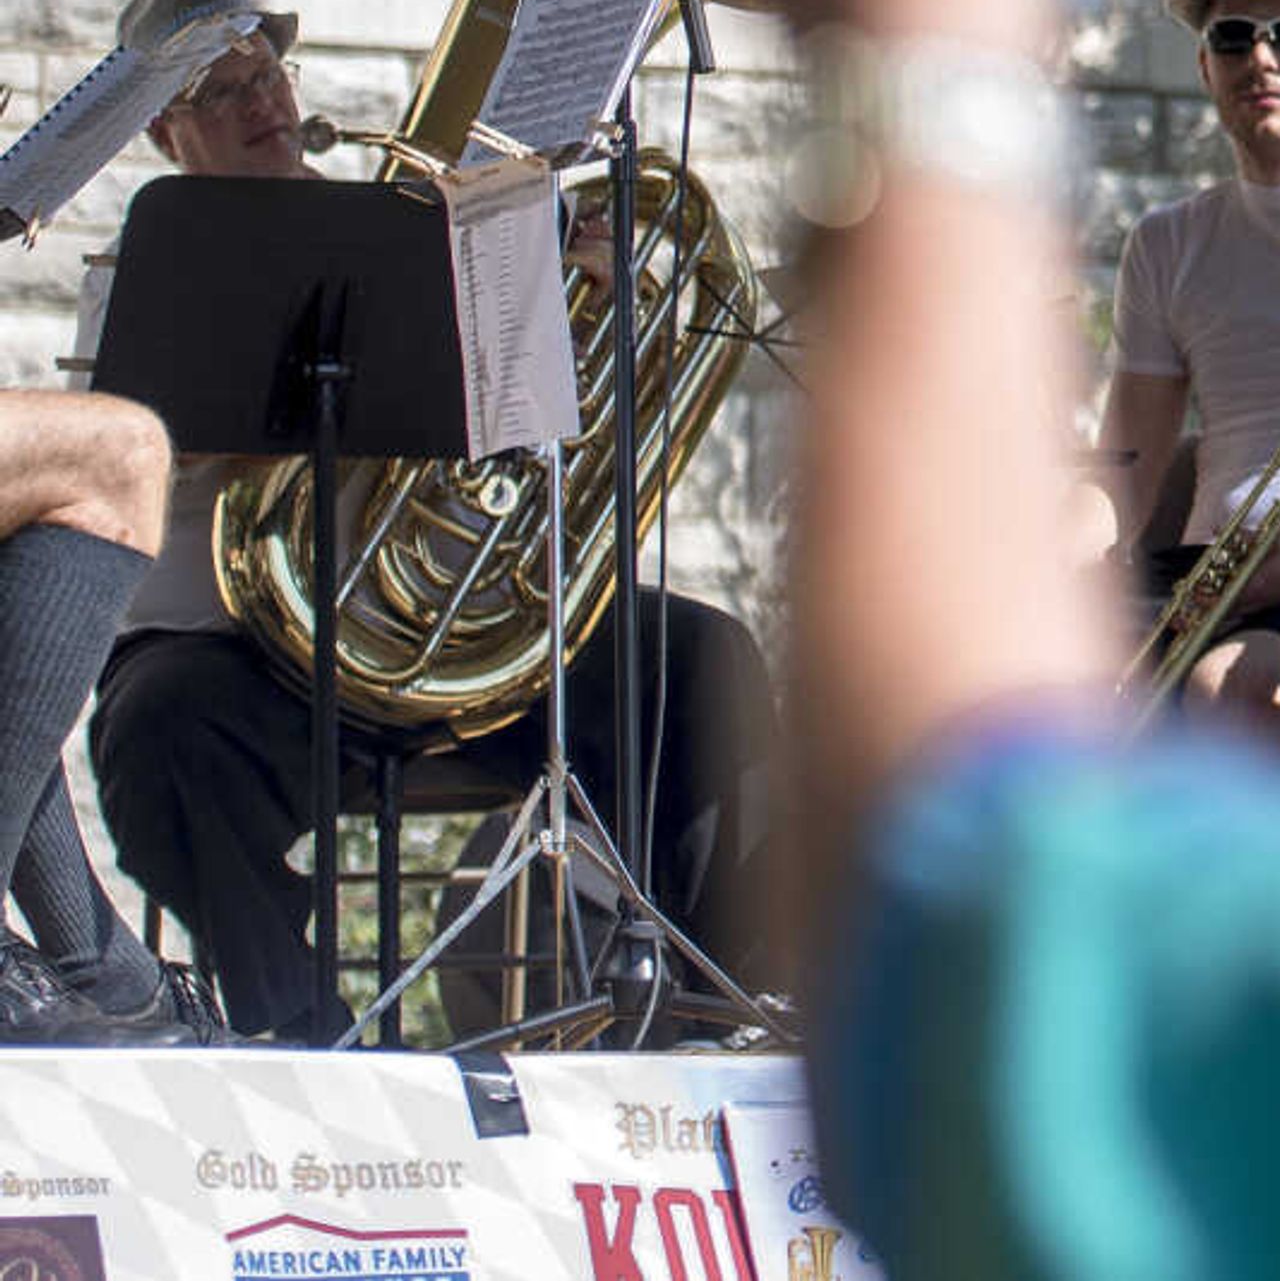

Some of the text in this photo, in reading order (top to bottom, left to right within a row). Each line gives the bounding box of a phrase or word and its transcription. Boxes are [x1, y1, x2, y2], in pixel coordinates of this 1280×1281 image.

[0, 1169, 112, 1200] Sponsor
[196, 1149, 467, 1197] Gold Sponsor
[232, 1244, 468, 1275] AMERICAN FAMILY
